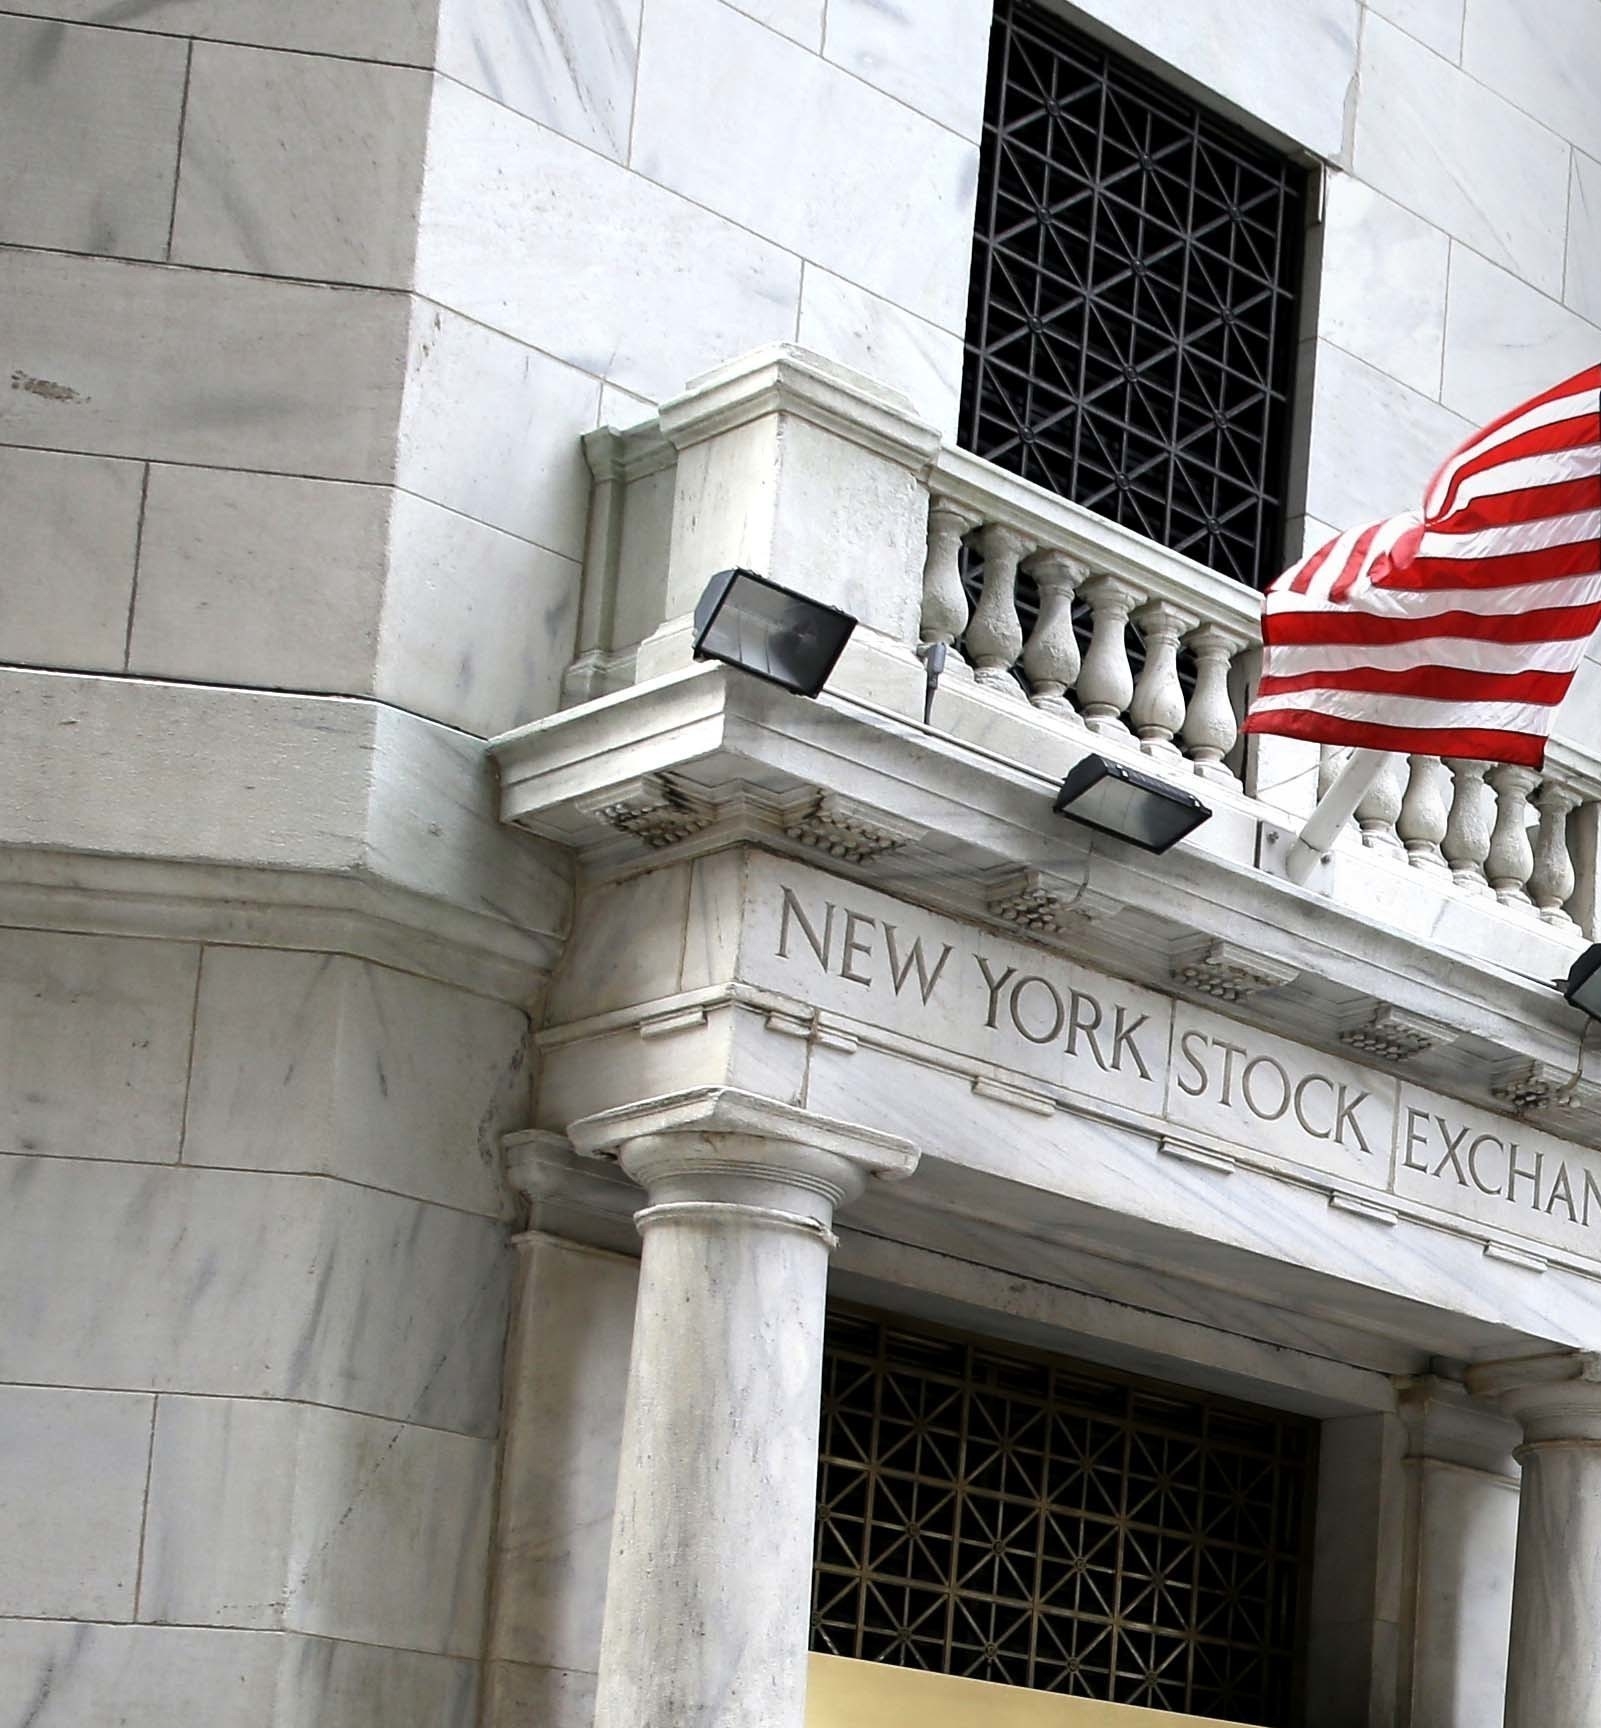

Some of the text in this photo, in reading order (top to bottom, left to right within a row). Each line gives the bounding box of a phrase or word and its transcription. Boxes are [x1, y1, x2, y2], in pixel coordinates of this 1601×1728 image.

[775, 884, 954, 1006] NEW
[973, 953, 1152, 1082] YORK
[1177, 1030, 1371, 1154] STOCK
